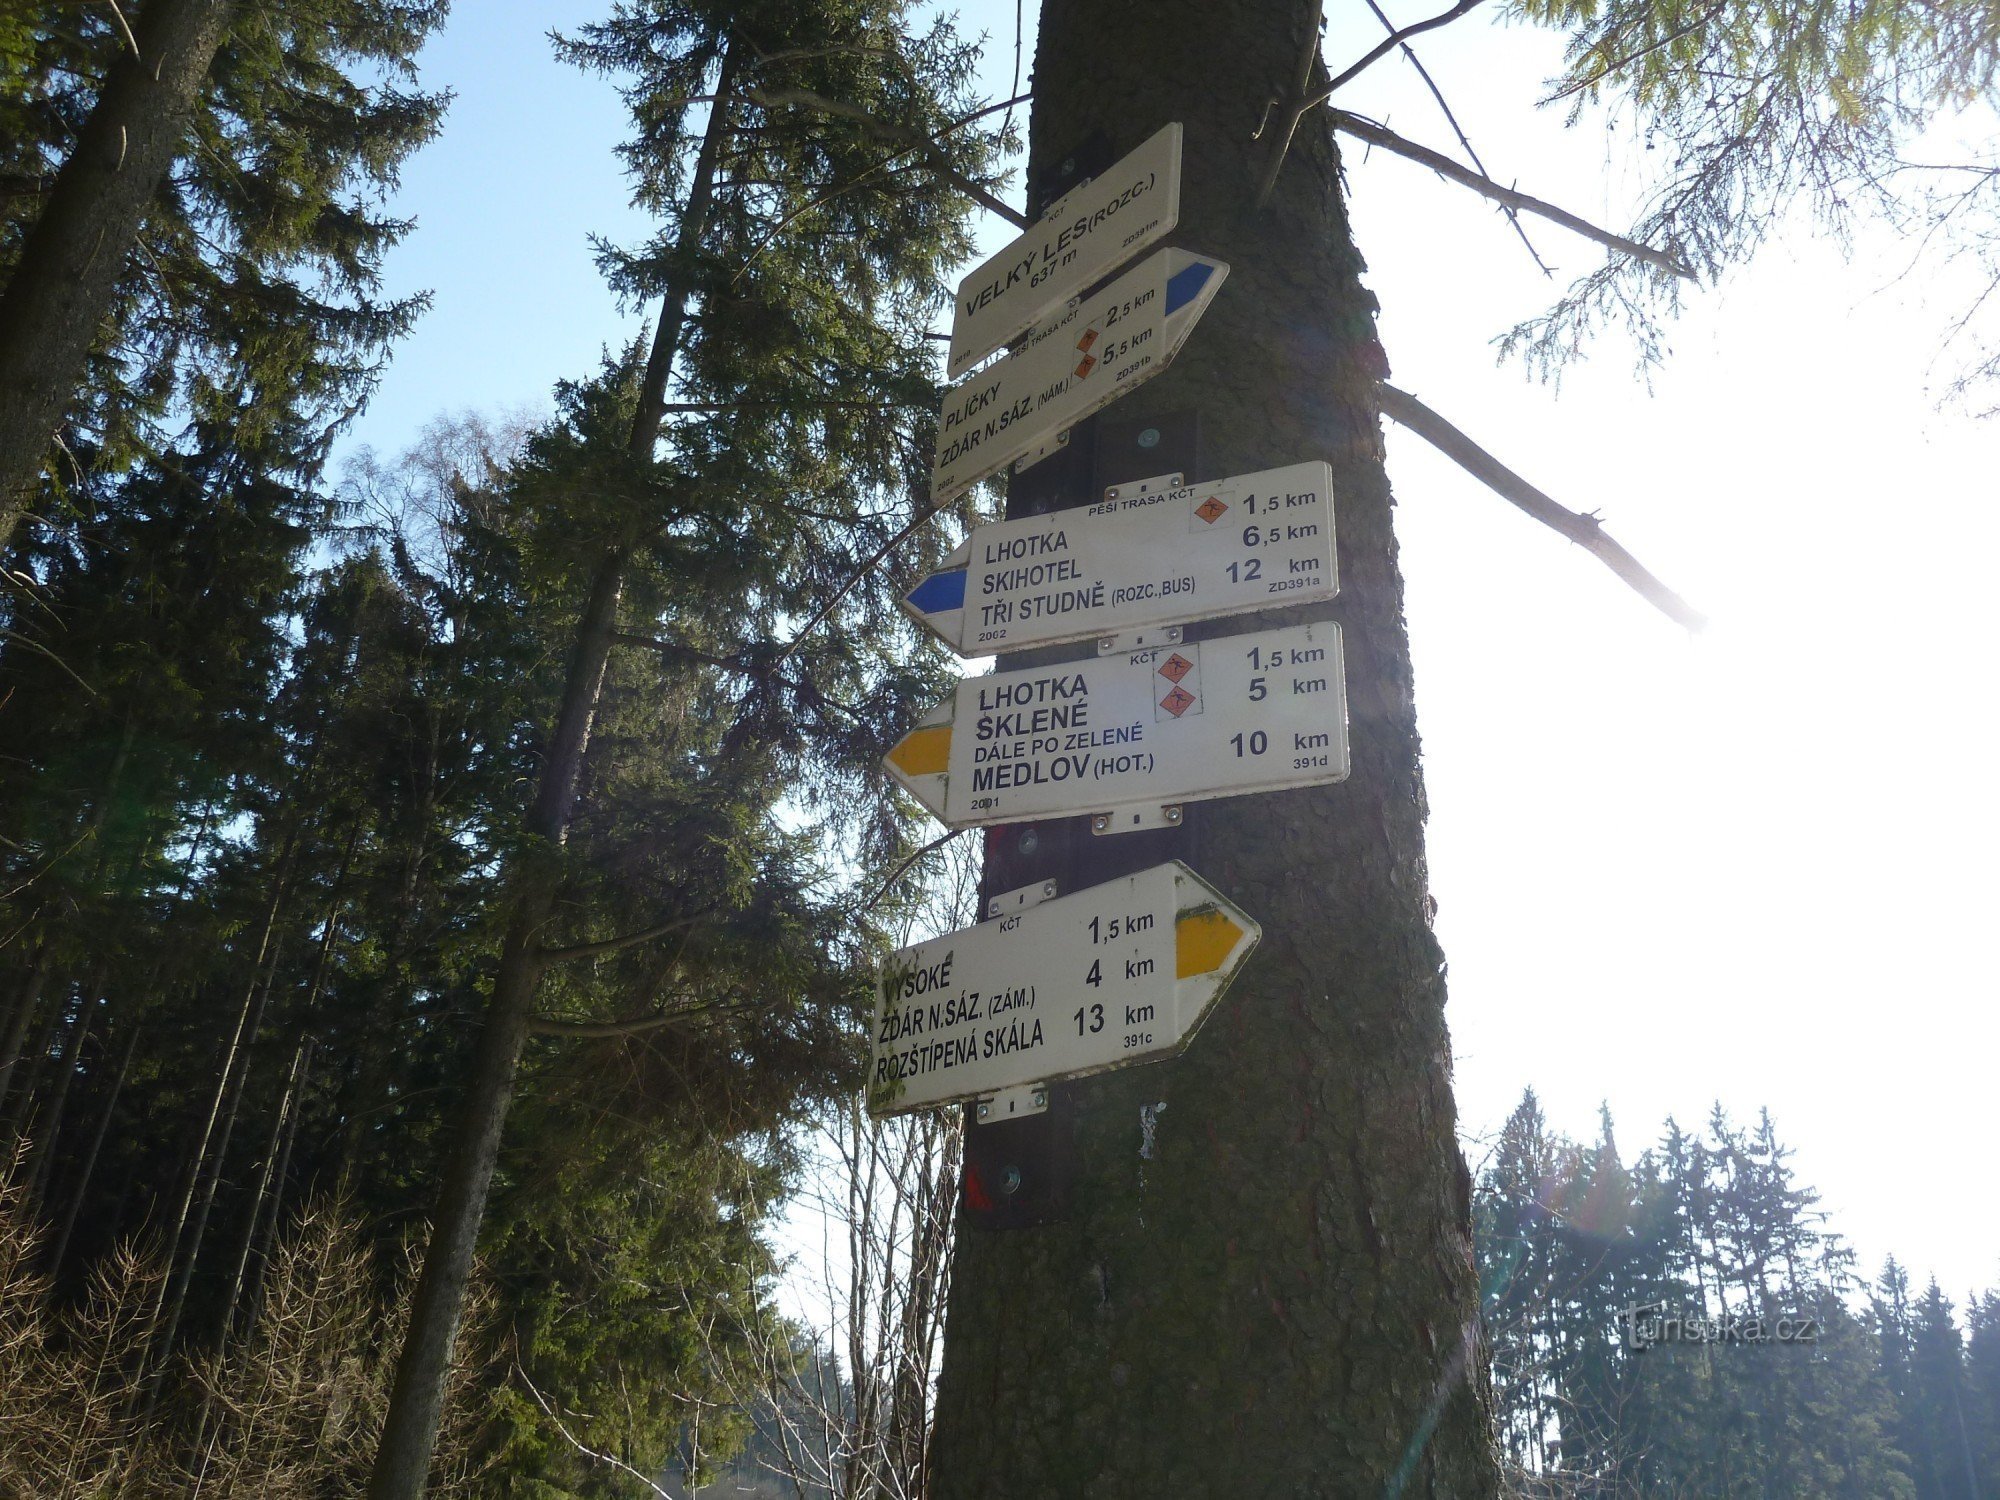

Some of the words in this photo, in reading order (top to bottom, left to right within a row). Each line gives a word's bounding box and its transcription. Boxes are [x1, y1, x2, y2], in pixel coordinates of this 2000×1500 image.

[1122, 220, 1158, 248] ZD391m
[1031, 259, 1058, 288] 637
[1063, 249, 1077, 266] m
[965, 251, 1037, 317] VELKÝ
[1105, 303, 1130, 328] 2,5
[1134, 289, 1155, 309] km
[1031, 324, 1059, 347] TRASA
[1102, 341, 1128, 366] 5,5
[1131, 328, 1153, 349] km
[954, 350, 971, 366] 2010
[1116, 356, 1151, 382] ZD391b
[945, 381, 1001, 432] PLÍČKY
[1037, 378, 1069, 410] (NÁM.)
[937, 475, 955, 492] 2002
[1088, 501, 1117, 517] PĚŠÍ
[1121, 494, 1165, 509] TRASA
[1169, 487, 1196, 500] KČT
[1243, 494, 1279, 516] 1,5
[1286, 491, 1316, 508] km
[985, 530, 1069, 565] LHOTKA
[1242, 525, 1281, 547] 6,5
[1287, 523, 1318, 540] km
[982, 559, 1082, 595] SKIHOTEL
[1225, 558, 1262, 584] 12
[1289, 557, 1320, 573] km
[1268, 576, 1321, 593] ZD391a
[981, 598, 1013, 627] TŘI
[1019, 580, 1105, 620] STUDNĚ
[978, 629, 1007, 642] 2002
[1130, 651, 1158, 666] KČT
[1247, 646, 1283, 672] 1,5
[1291, 648, 1325, 665] km
[979, 673, 1089, 711] LHOTKA
[1248, 677, 1267, 702] 5
[1293, 678, 1326, 695] km
[976, 698, 1088, 741] SKLENÉ
[974, 741, 1025, 764] DÁLE
[1031, 736, 1059, 756] PO
[1064, 721, 1143, 751] ZELENÉ
[1230, 730, 1268, 758] 10
[1294, 733, 1329, 750] km
[1293, 755, 1328, 770] 391d
[970, 797, 999, 810] 2001
[1000, 916, 1021, 933] KČT
[1088, 916, 1119, 944] 1,5
[1126, 913, 1154, 935] km
[1086, 958, 1102, 988] 4
[1125, 958, 1154, 979] km
[988, 985, 1035, 1020] (ZÁM.)
[1073, 1003, 1104, 1036] 13
[1125, 1004, 1154, 1026] km
[876, 1028, 978, 1083] ROZŠTÍPENÁ
[983, 1017, 1043, 1059] SKÁLA
[1123, 1032, 1152, 1049] 391c
